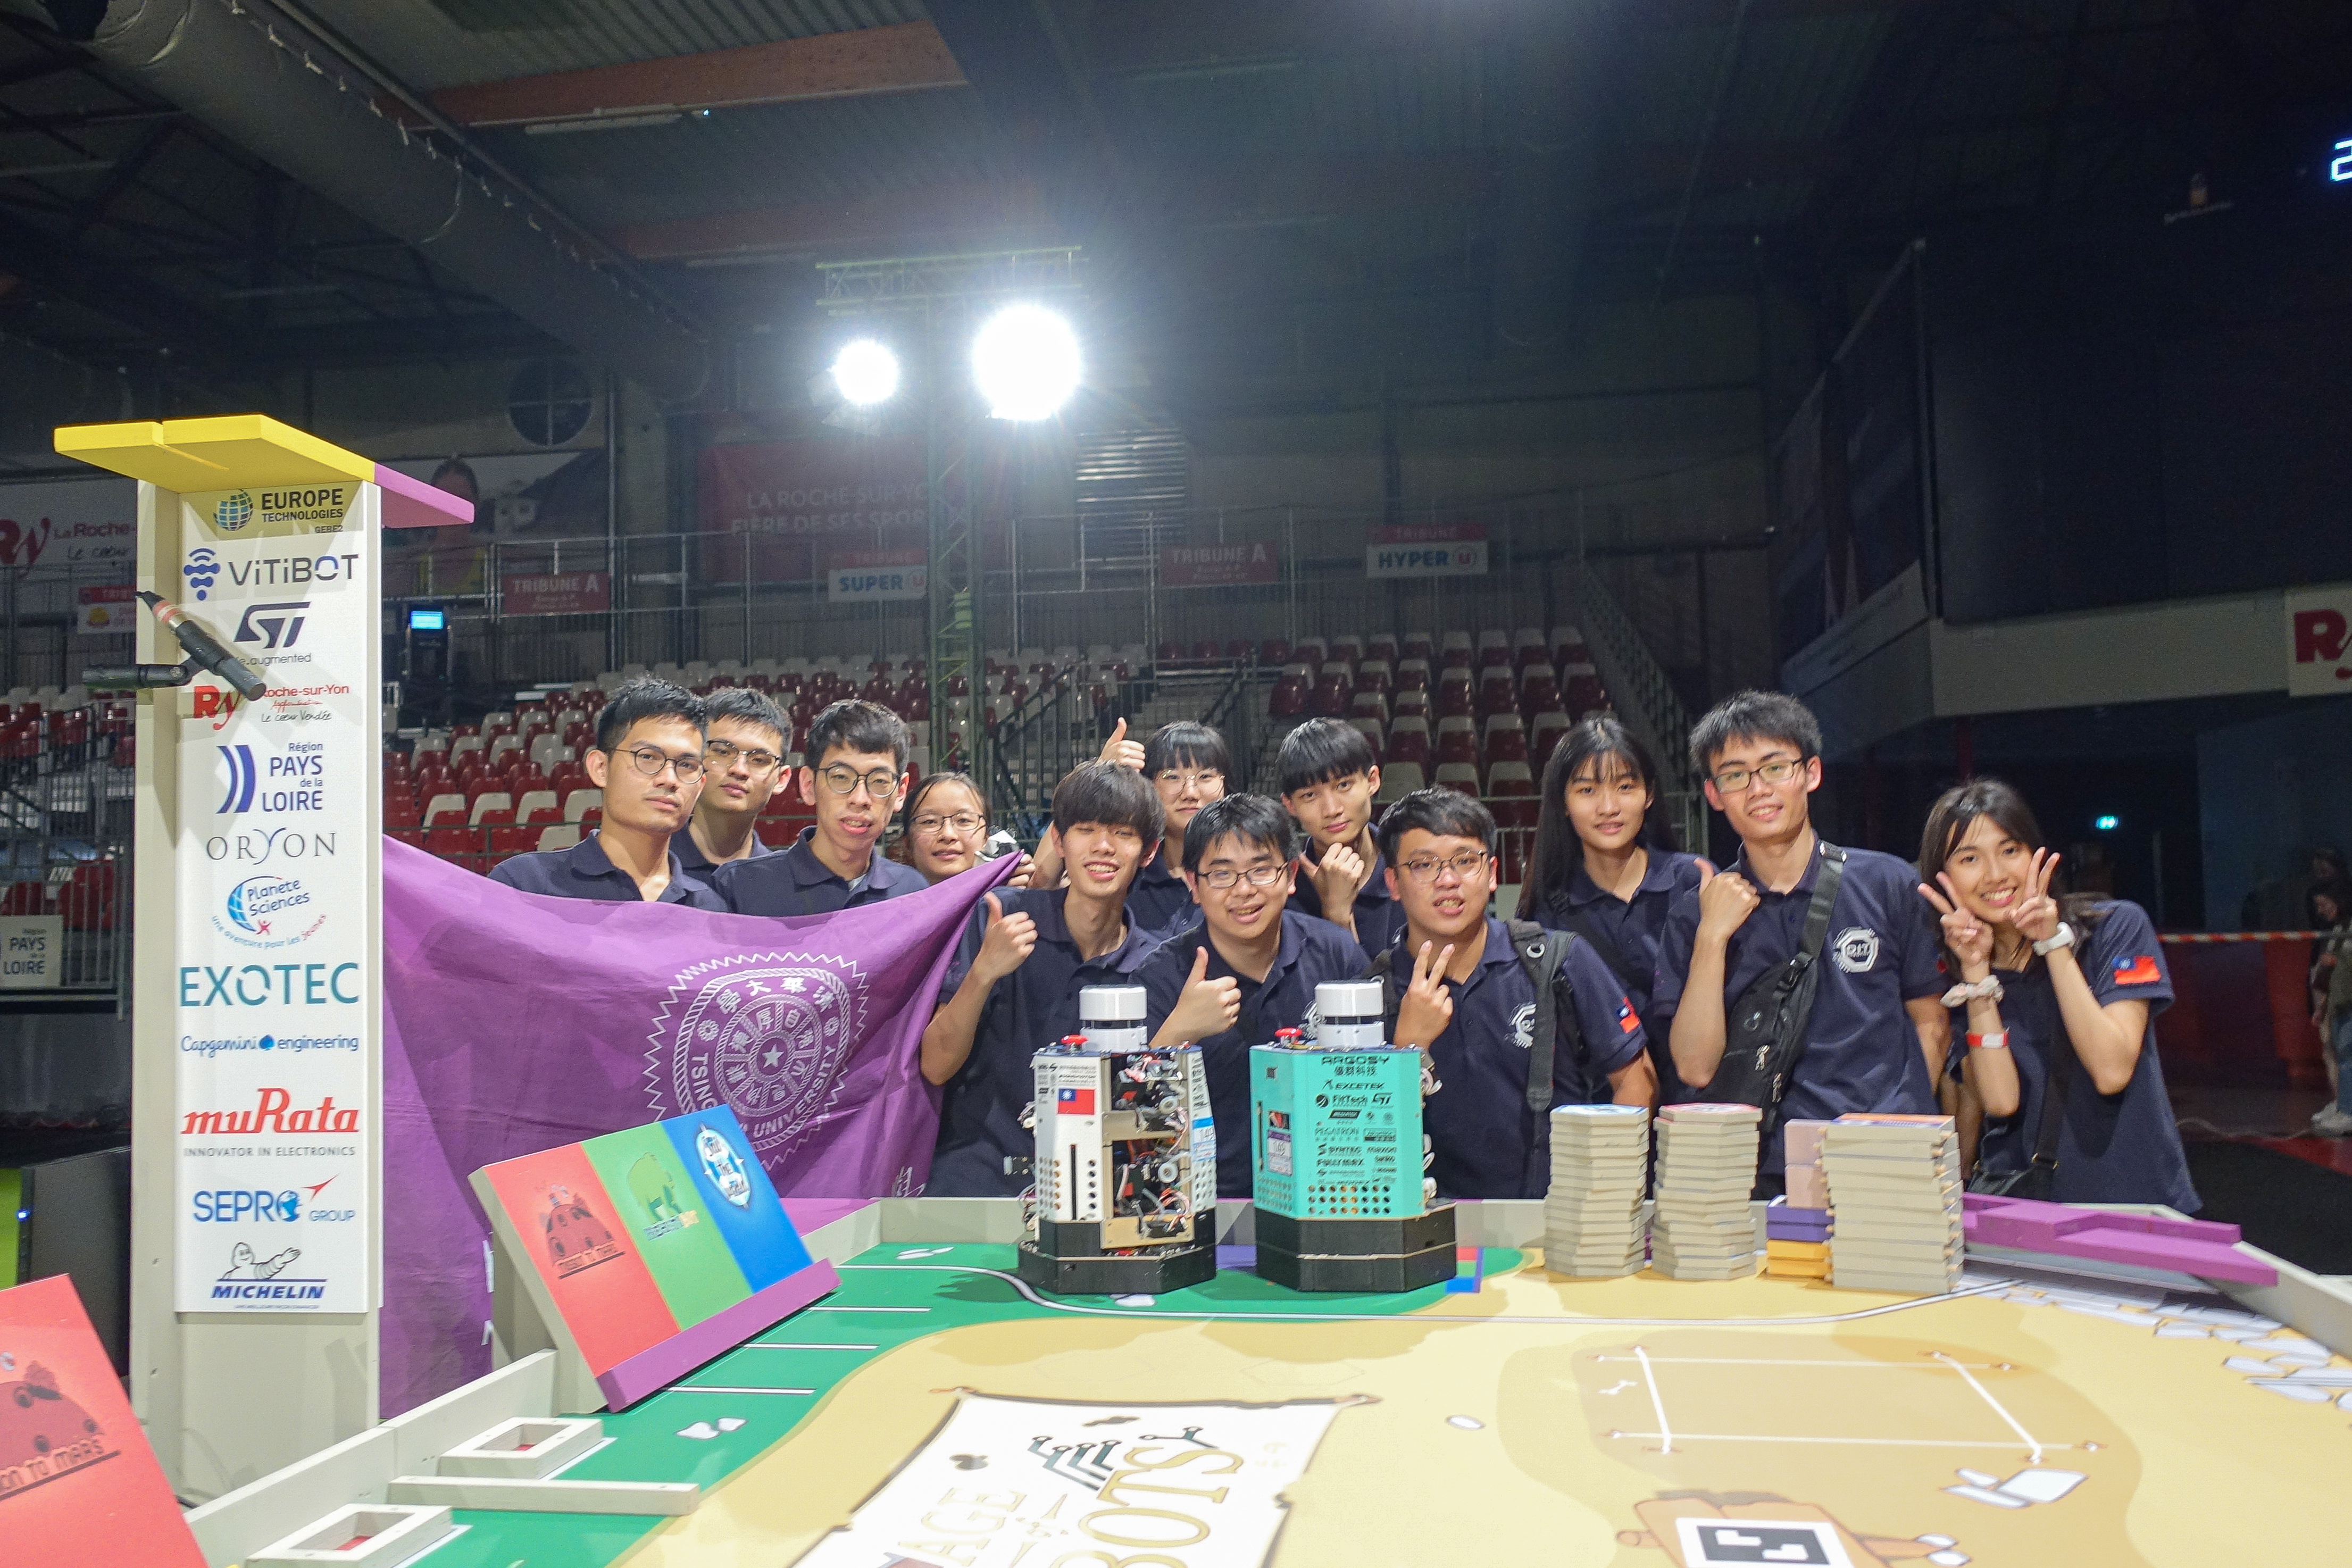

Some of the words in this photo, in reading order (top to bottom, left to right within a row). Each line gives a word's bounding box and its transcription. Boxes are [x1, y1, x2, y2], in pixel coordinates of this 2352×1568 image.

[261, 488, 343, 510] EUROPE
[747, 492, 772, 509] LA
[262, 508, 343, 523] TECHNOLOGIES
[793, 515, 822, 533] DE
[868, 508, 927, 527] SPOR
[1171, 547, 1246, 564] TRIBUNE
[1252, 543, 1266, 563] A
[1378, 551, 1449, 568] HYPER
[513, 577, 580, 594] TRIBUNE
[585, 573, 599, 593] A
[839, 574, 903, 592] SUPER
[236, 653, 312, 666] e.augmented
[265, 683, 349, 698] oche-sur-Yon
[288, 742, 323, 753] Région
[269, 755, 323, 777] PAYS
[299, 778, 312, 787] de
[314, 778, 323, 787] la
[262, 790, 323, 812] LOIRE
[206, 827, 336, 865] ORYON
[249, 892, 311, 917] Sciences
[10, 937, 46, 951] PAYS
[4, 960, 45, 975] LOIRE
[180, 962, 360, 1007] EXOTEC
[181, 1035, 257, 1058] Capgemini
[278, 1034, 360, 1053] engineering
[180, 1088, 360, 1134] muRata
[184, 1147, 253, 1157] INNOVATOR
[257, 1147, 272, 1156] IN
[276, 1146, 356, 1156] ELECTRONICS
[193, 1189, 303, 1223] SEPRO
[308, 1210, 356, 1222] GROUP
[211, 1285, 326, 1299] MICHELIN
